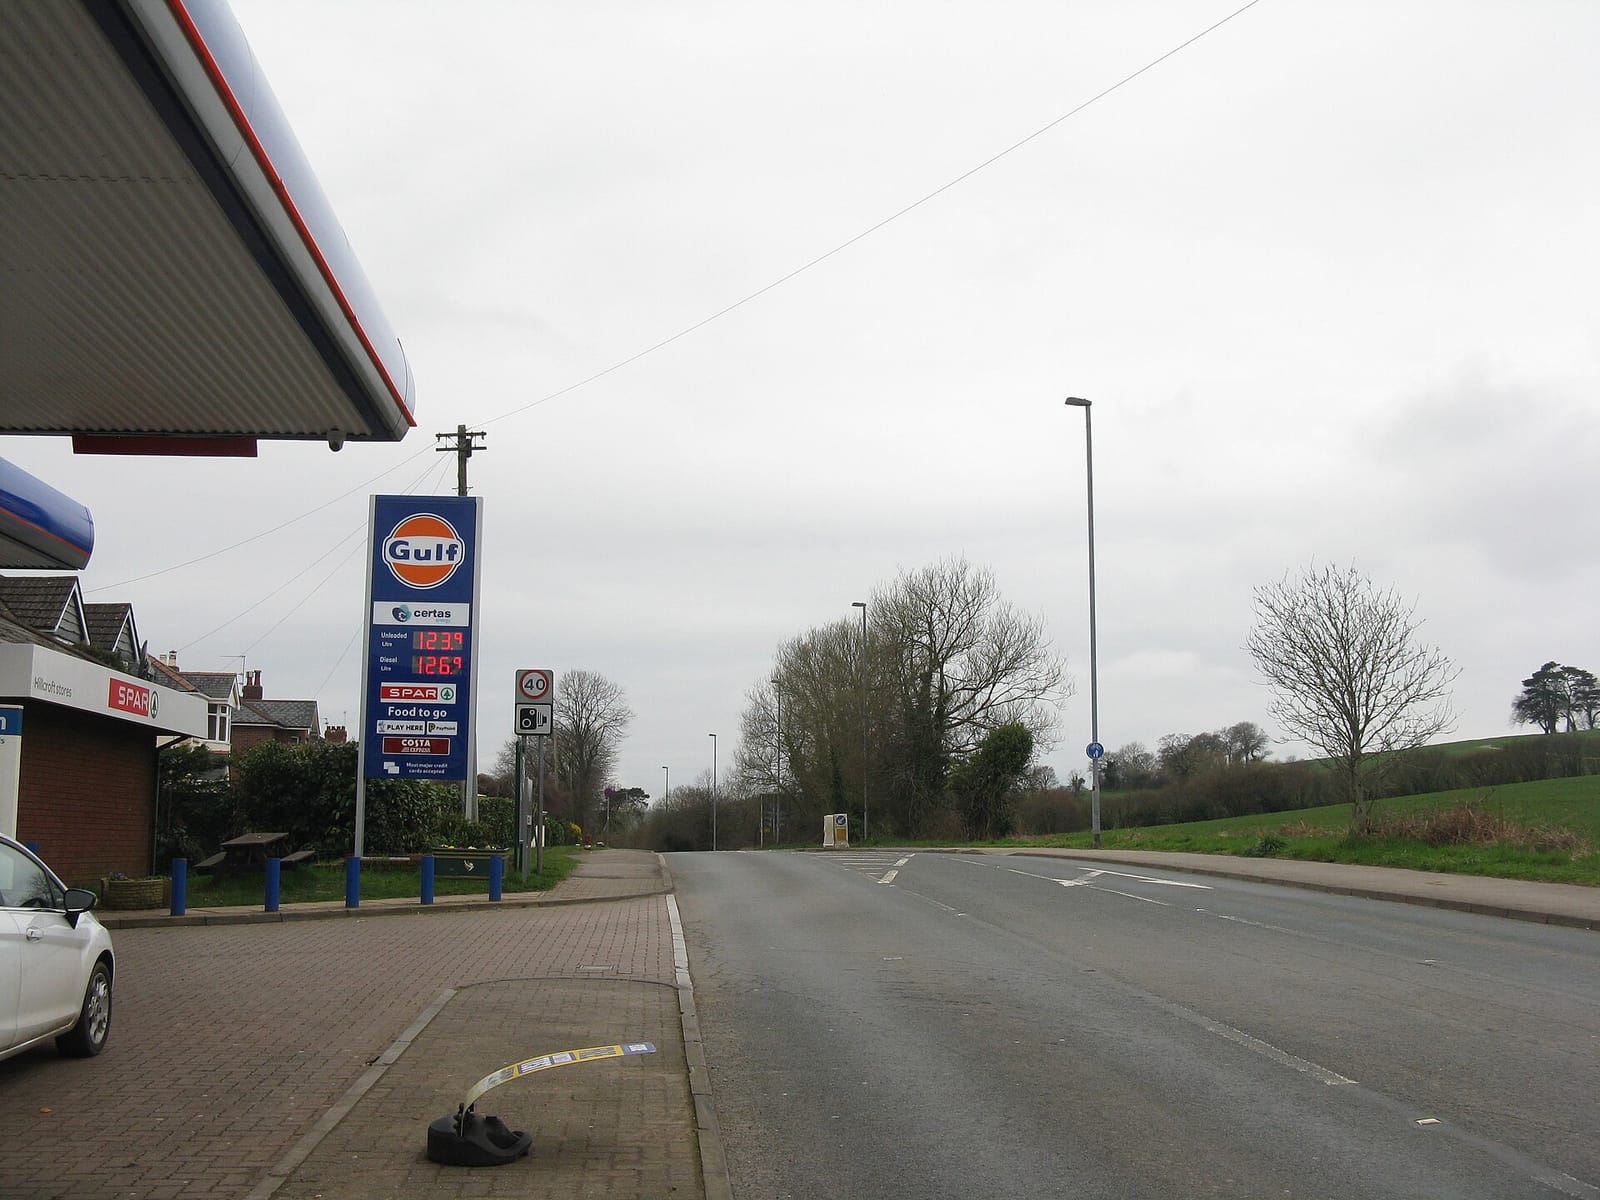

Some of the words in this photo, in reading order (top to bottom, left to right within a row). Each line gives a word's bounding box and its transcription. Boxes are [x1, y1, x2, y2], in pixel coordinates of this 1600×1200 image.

[388, 540, 459, 561] Gulf
[414, 609, 451, 618] certas
[524, 679, 545, 690] 40
[56, 685, 72, 698] stores
[389, 688, 437, 698] SPAR
[118, 686, 149, 711] SPAR
[388, 706, 416, 717] Food
[418, 708, 430, 717] to
[433, 710, 447, 720] go
[401, 739, 431, 747] COSTA
